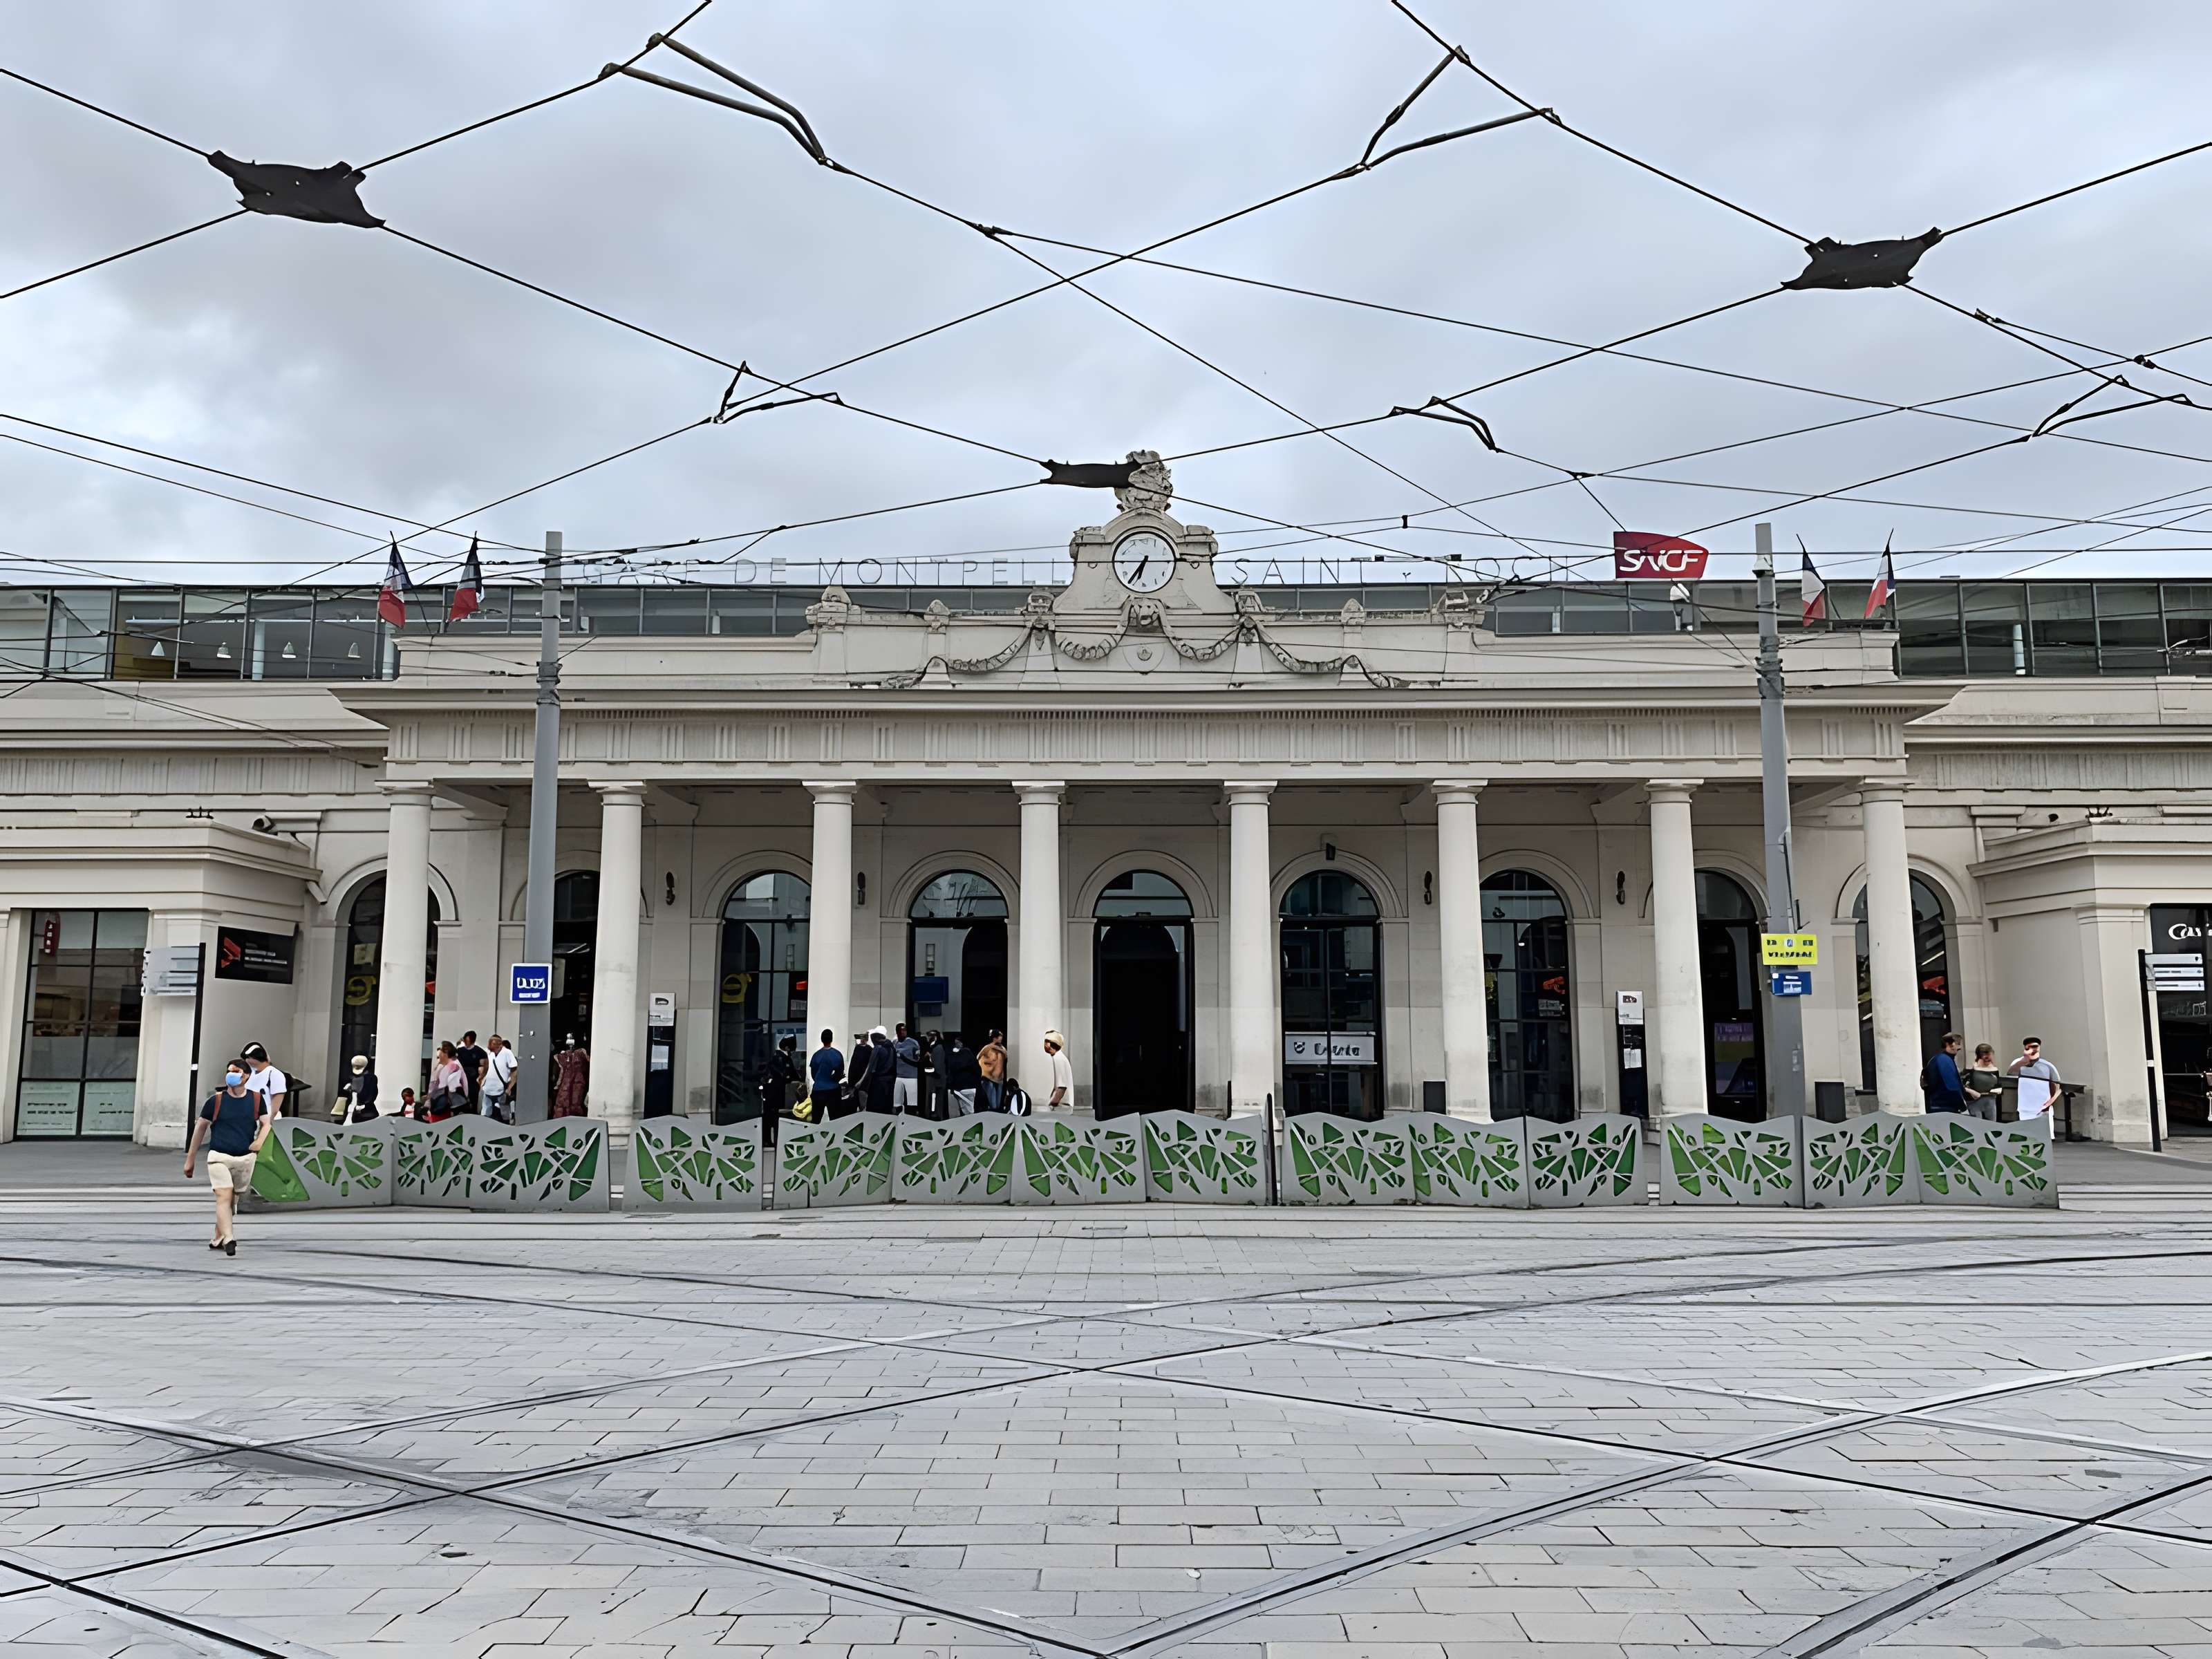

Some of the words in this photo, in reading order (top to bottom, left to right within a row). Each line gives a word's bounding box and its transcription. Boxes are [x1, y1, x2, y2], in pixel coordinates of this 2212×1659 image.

[735, 557, 787, 584] DE
[818, 557, 1067, 585] MONTPELL
[1230, 556, 1372, 585] SAINT
[1619, 549, 1704, 572] SNCF
